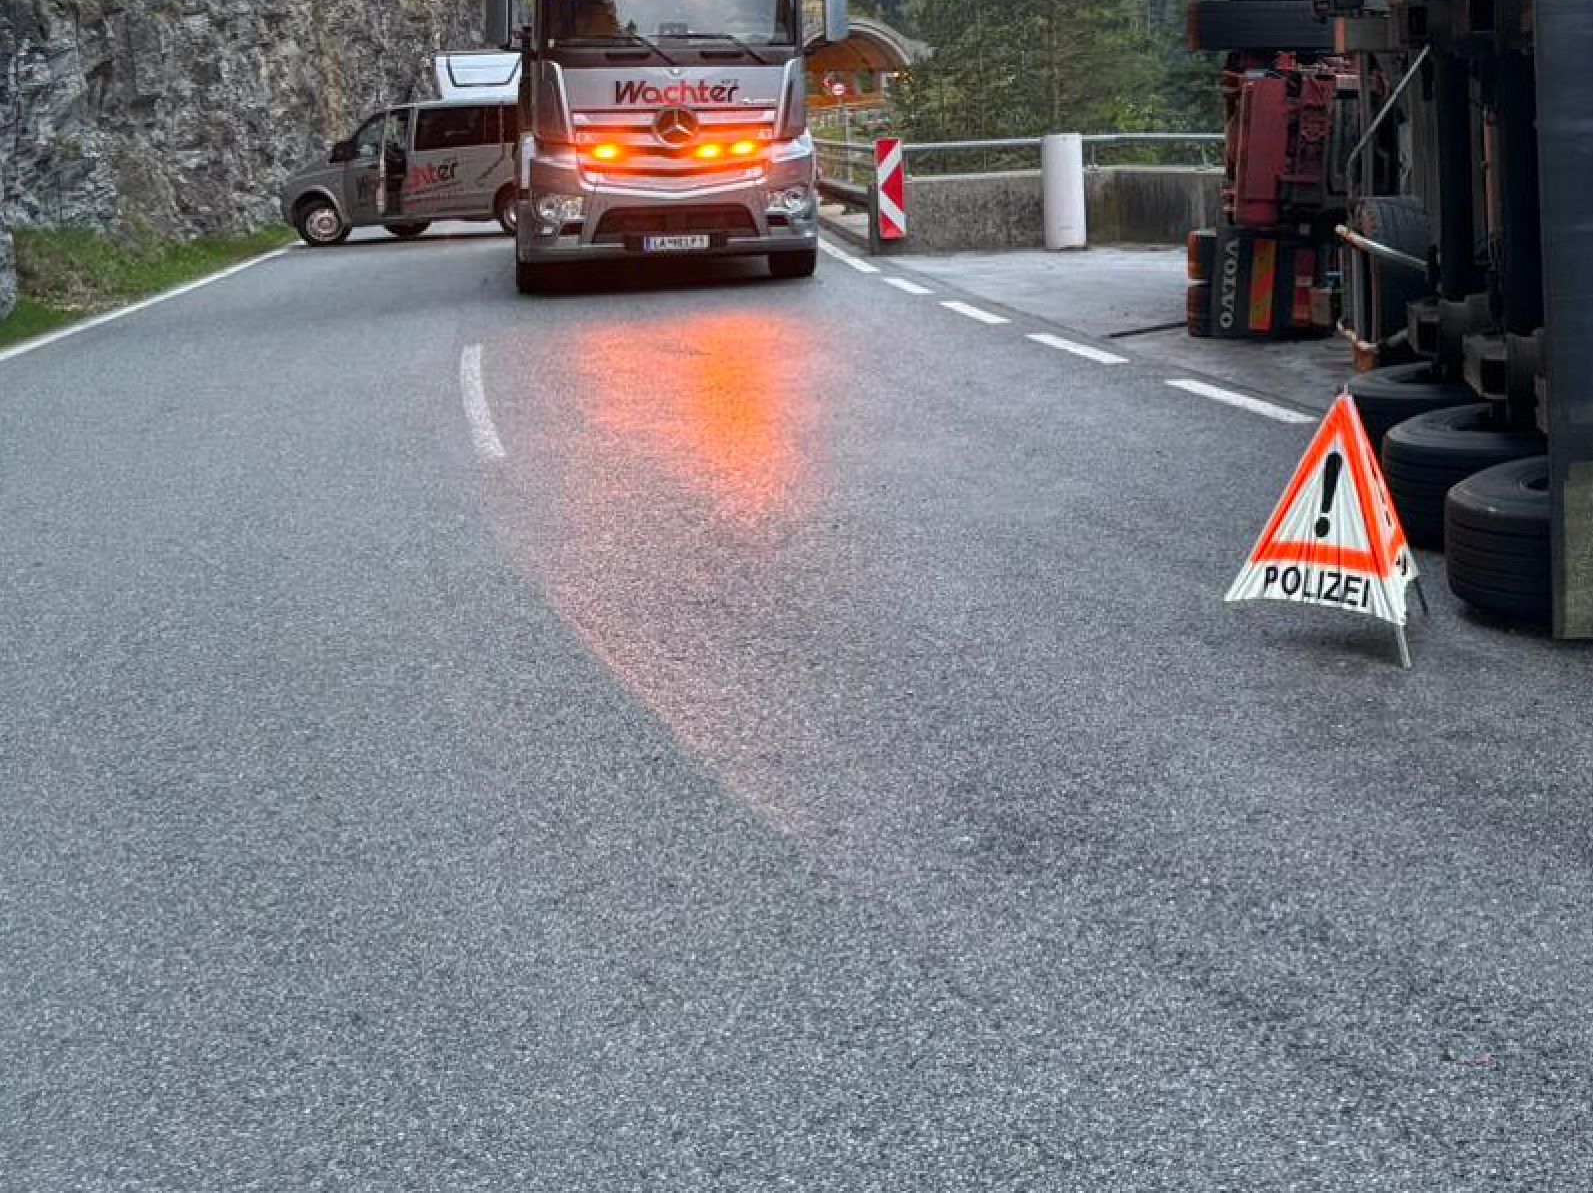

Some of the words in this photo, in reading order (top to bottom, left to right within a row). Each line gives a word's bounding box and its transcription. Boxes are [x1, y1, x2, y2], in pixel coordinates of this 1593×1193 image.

[615, 80, 740, 104] Wachter
[1219, 238, 1238, 328] VOLVO
[1264, 566, 1371, 608] POLIZEI
